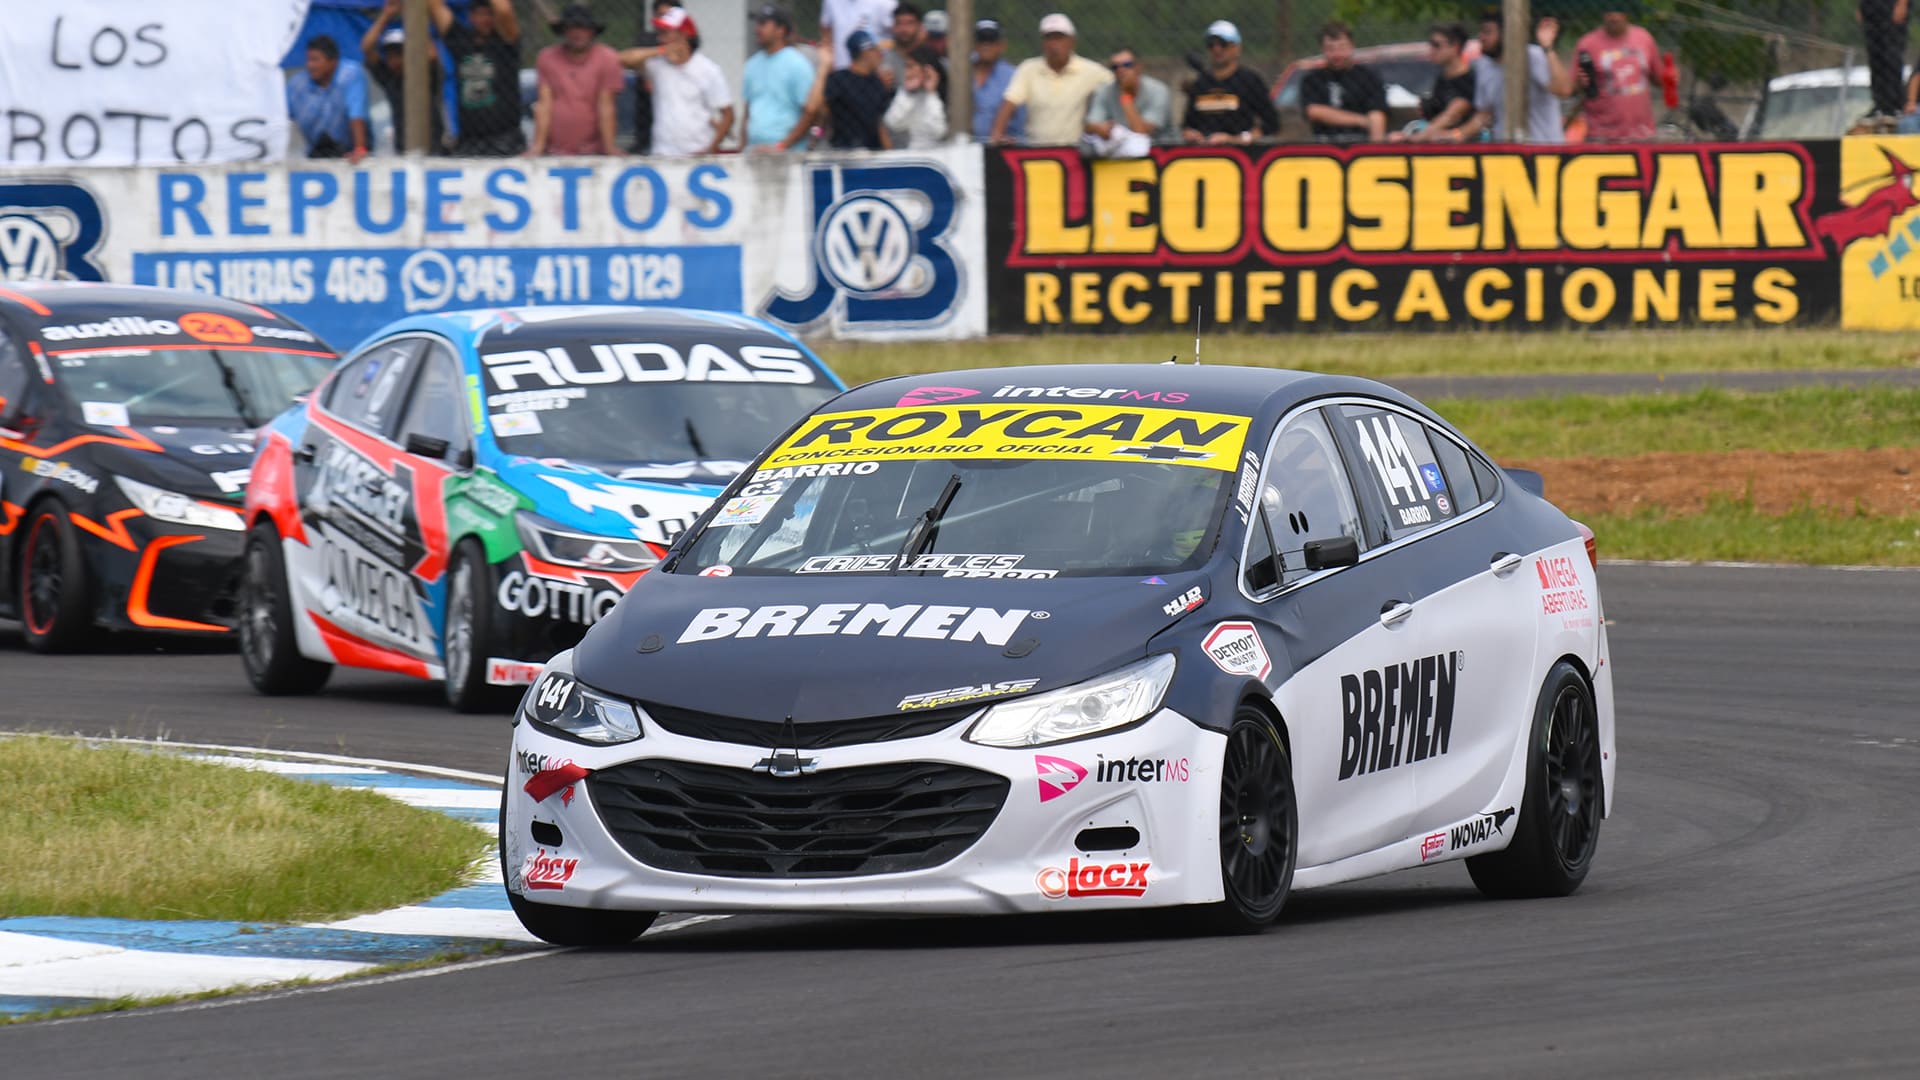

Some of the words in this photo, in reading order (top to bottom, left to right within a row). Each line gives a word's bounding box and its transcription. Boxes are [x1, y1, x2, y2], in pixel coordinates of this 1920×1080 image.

[52, 16, 168, 69] LOS
[158, 164, 733, 237] REPUESTOS
[1263, 151, 1807, 252] OSENGAR
[156, 261, 216, 296] LAS
[219, 257, 316, 304] HERAS
[325, 256, 388, 304] 466
[456, 255, 516, 302] 345
[533, 255, 591, 302] 411
[607, 253, 684, 301] 9129
[1024, 267, 1799, 324] RECTIFICACIONES
[481, 342, 816, 391] RUDAS
[789, 409, 1240, 449] ROYCAN
[749, 460, 880, 484] BARRIO
[772, 443, 984, 464] CONCESIONARIO
[996, 443, 1095, 454] OFICIAL
[1355, 414, 1431, 507] 141
[740, 480, 784, 498] C3
[1399, 504, 1432, 526] BARRIO
[795, 554, 1026, 574] CRISALES
[1542, 556, 1581, 590] MEGA
[676, 602, 1033, 647] BREMEN
[1211, 634, 1256, 661] DETROIT
[1227, 650, 1258, 668] INDUSTRY
[538, 676, 575, 712] 141
[1338, 650, 1457, 781] BREMEN
